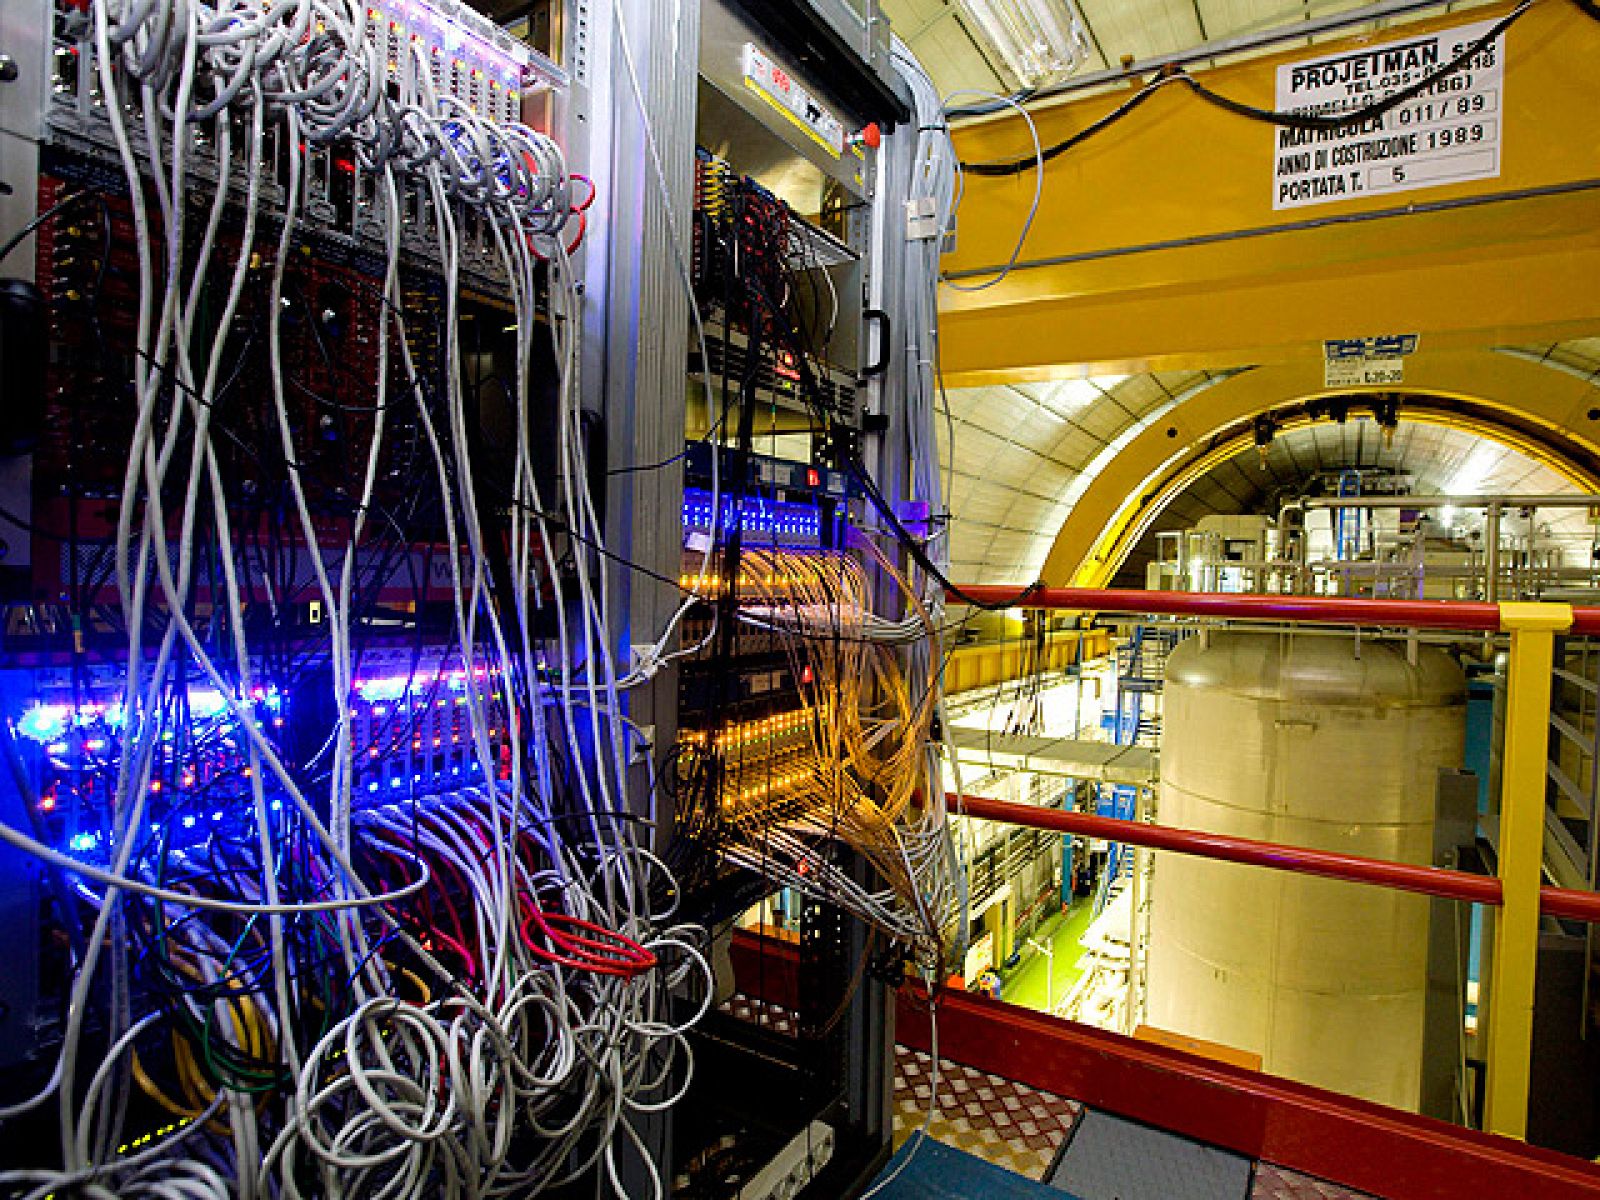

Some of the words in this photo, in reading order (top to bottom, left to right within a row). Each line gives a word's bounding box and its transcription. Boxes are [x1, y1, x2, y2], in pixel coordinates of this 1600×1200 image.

[1277, 152, 1311, 177] ANNO
[1314, 149, 1328, 171] DI
[1332, 134, 1418, 168] COSTRUZIONE
[1428, 124, 1484, 149] 1989
[1279, 174, 1346, 203] PORTATA
[1350, 171, 1363, 192] T.
[1392, 164, 1405, 183] 5
